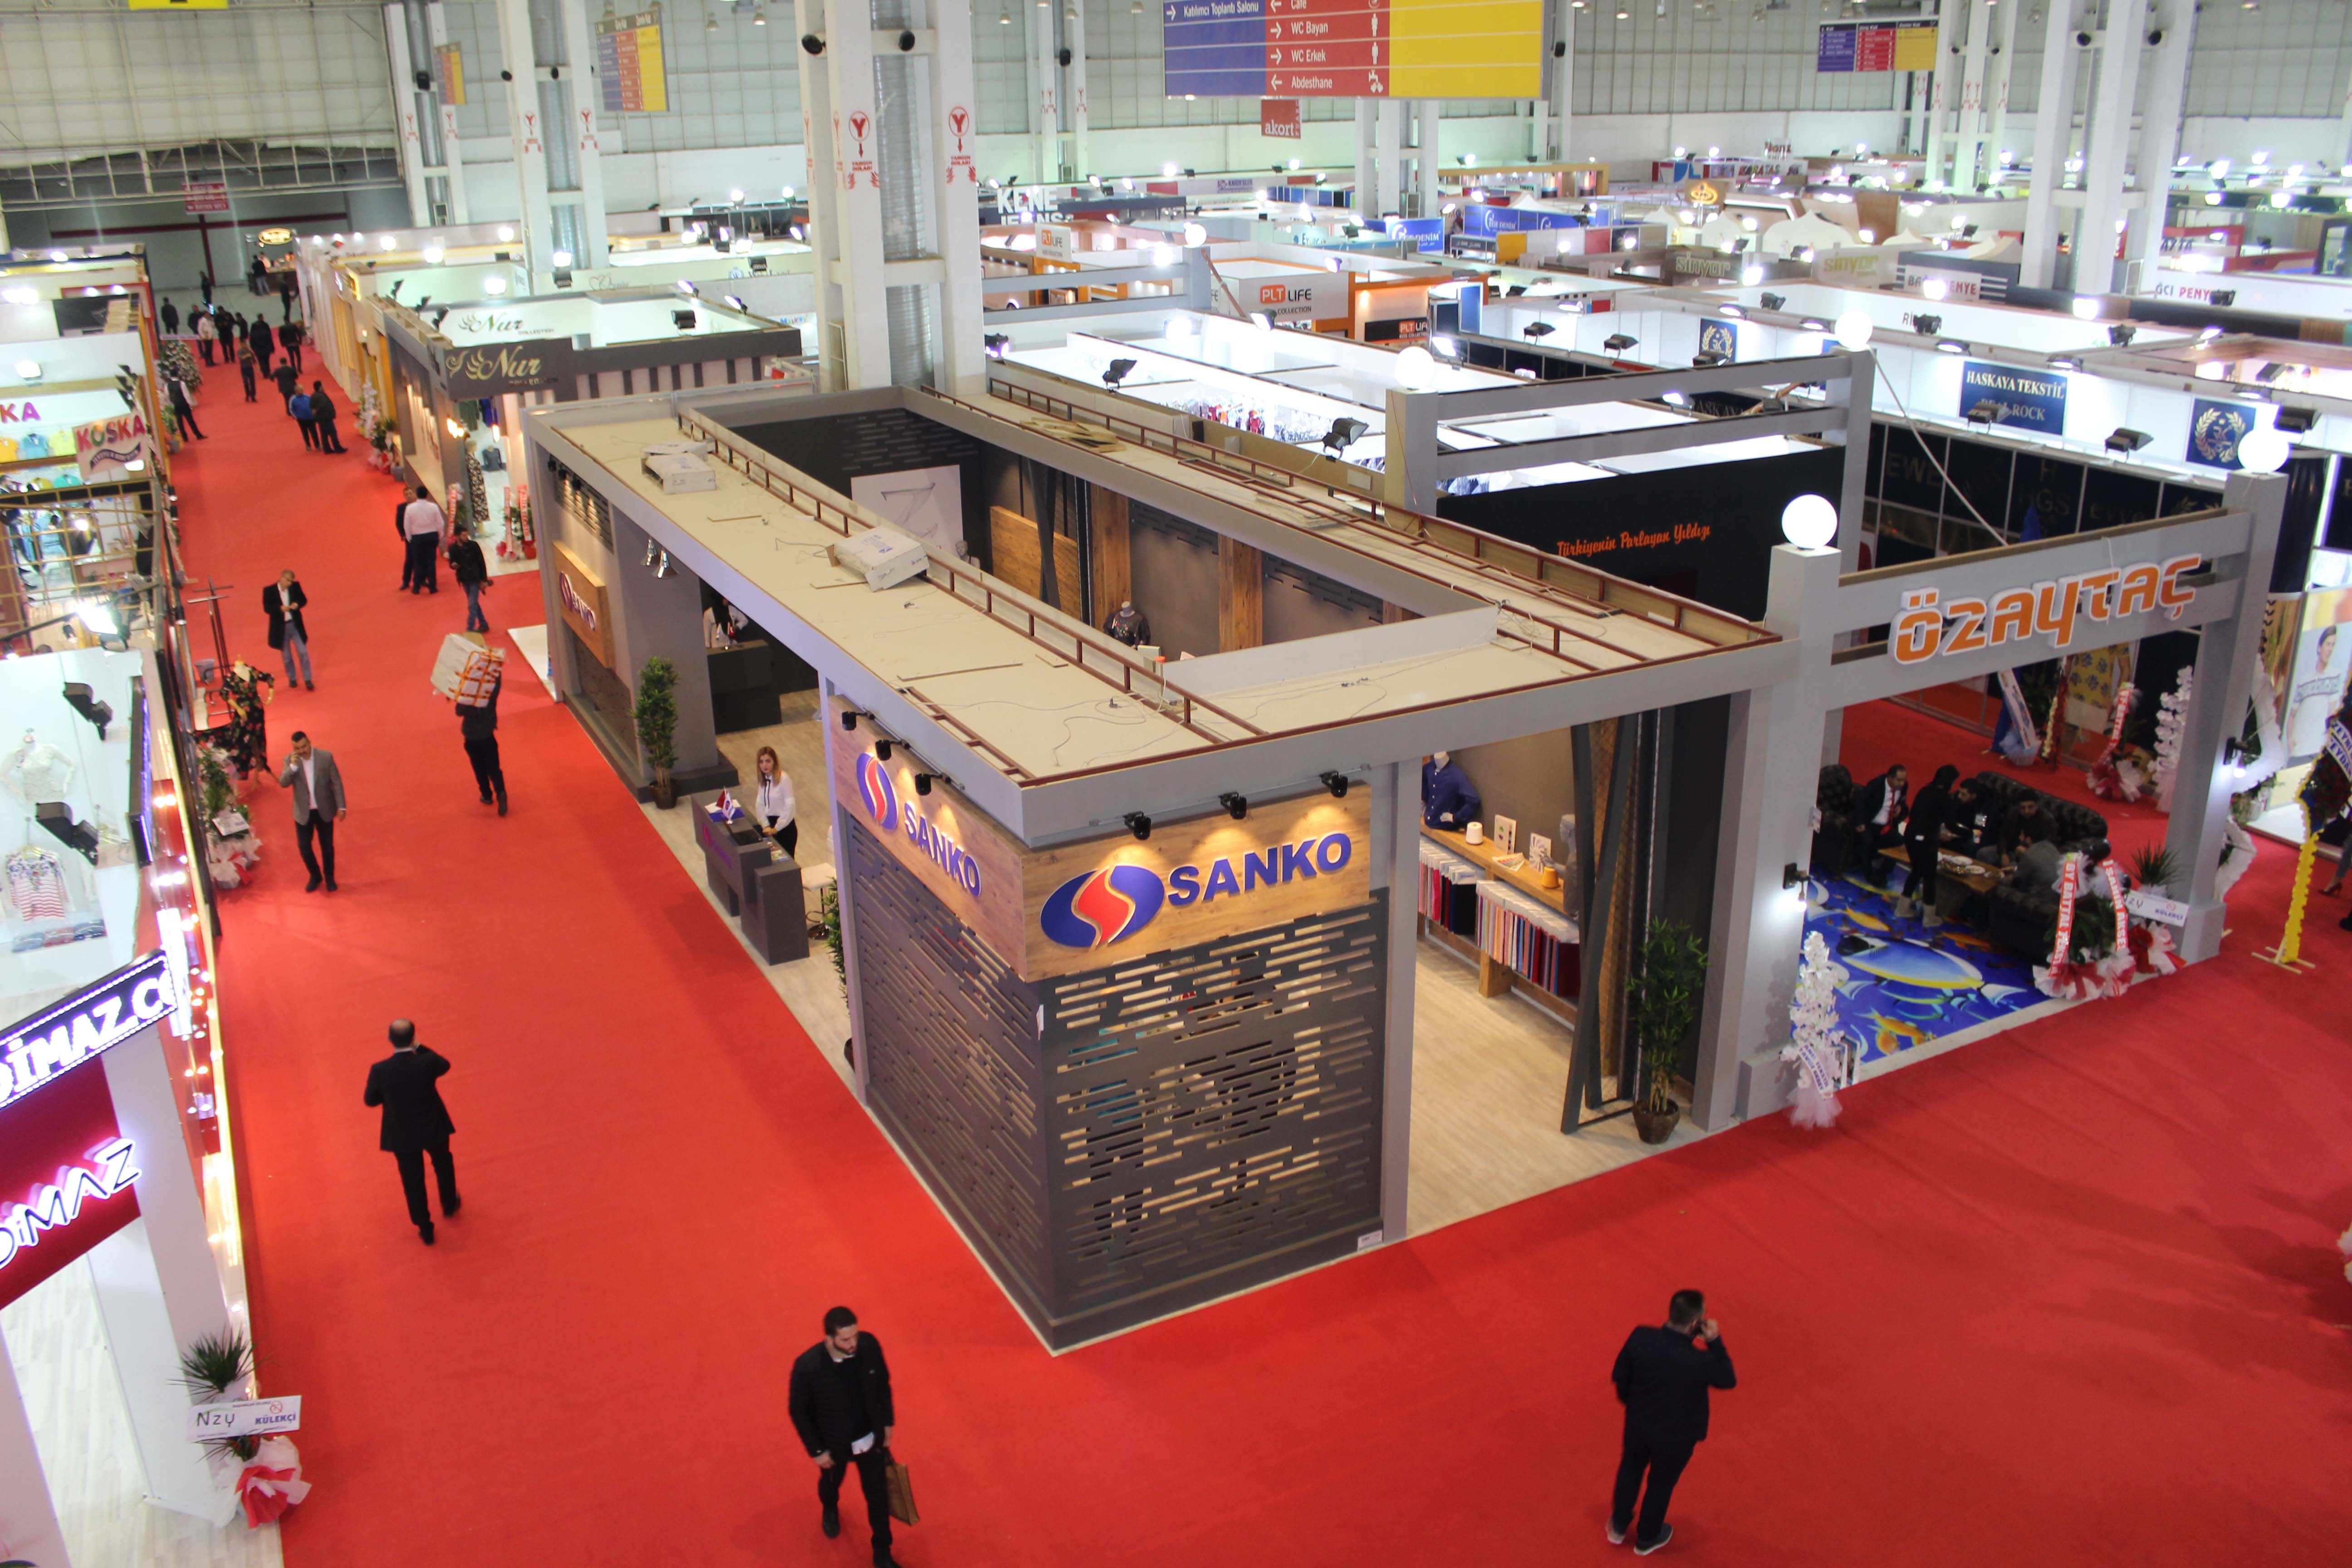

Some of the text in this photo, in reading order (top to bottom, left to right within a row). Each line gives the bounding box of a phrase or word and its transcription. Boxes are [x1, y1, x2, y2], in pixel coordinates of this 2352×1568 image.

[1211, 2, 1235, 17] Toplantı
[1236, 1, 1259, 14] Salonu
[1291, 21, 1328, 36] WC Bayan
[1291, 49, 1326, 63] WC Erkek
[1291, 76, 1333, 89] Abdesthane
[1264, 118, 1294, 137] akort
[998, 186, 1058, 215] KENE
[1676, 252, 1731, 279] sinyor
[1823, 252, 1879, 273] sinyor
[1262, 288, 1312, 302] PLT LIFE
[2179, 287, 2210, 302] PENY
[1277, 306, 1312, 315] COLLECTION
[1400, 323, 1414, 333] PLT
[477, 345, 541, 380] Nur
[1966, 370, 2065, 400] HASKAYA TEKSTİL
[2012, 403, 2046, 421] ROCK
[76, 415, 146, 452] KOSKA
[1557, 522, 1711, 557] Türkiyenin Parlayan Yıldızı
[903, 801, 982, 897] SANKO
[1167, 832, 1352, 907] SANKO
[255, 1413, 297, 1426] KÜLEKÇİ
